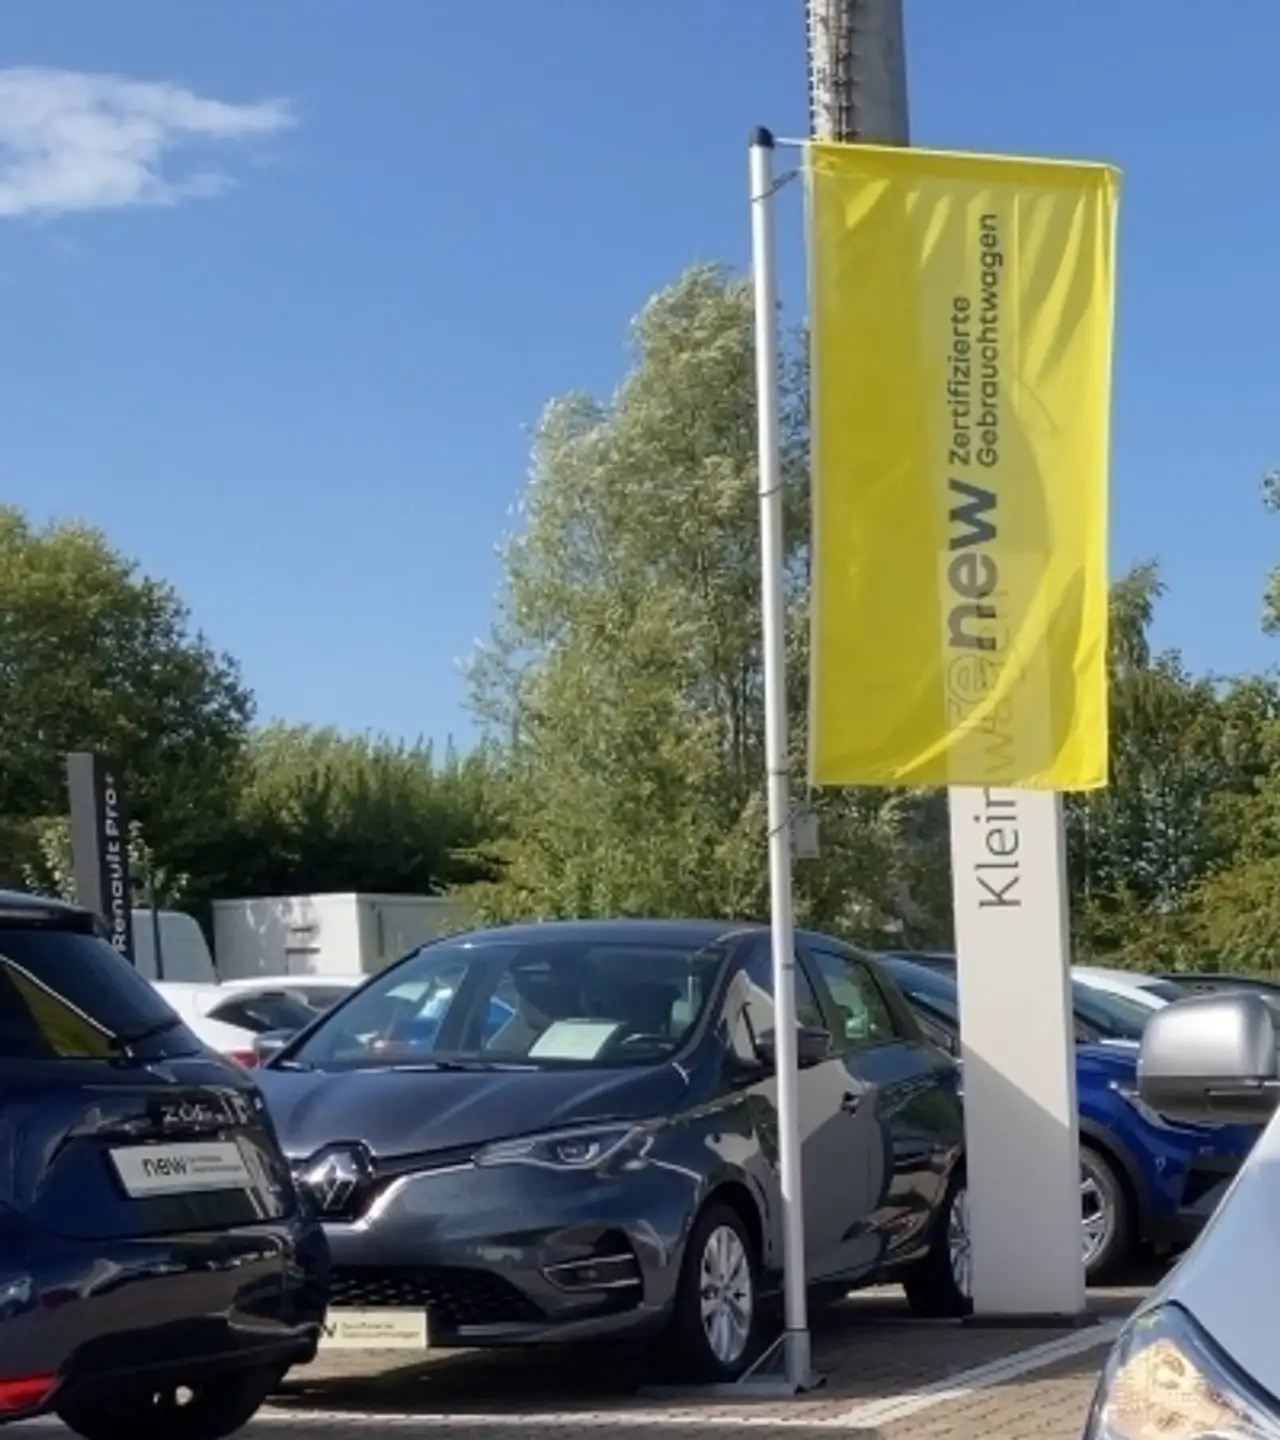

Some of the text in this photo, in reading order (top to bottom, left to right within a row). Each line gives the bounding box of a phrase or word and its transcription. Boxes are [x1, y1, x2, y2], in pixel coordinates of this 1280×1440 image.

[948, 296, 971, 466] Zertifizierte
[976, 213, 1004, 468] Gebrauchtwagen
[105, 841, 127, 951] Renault
